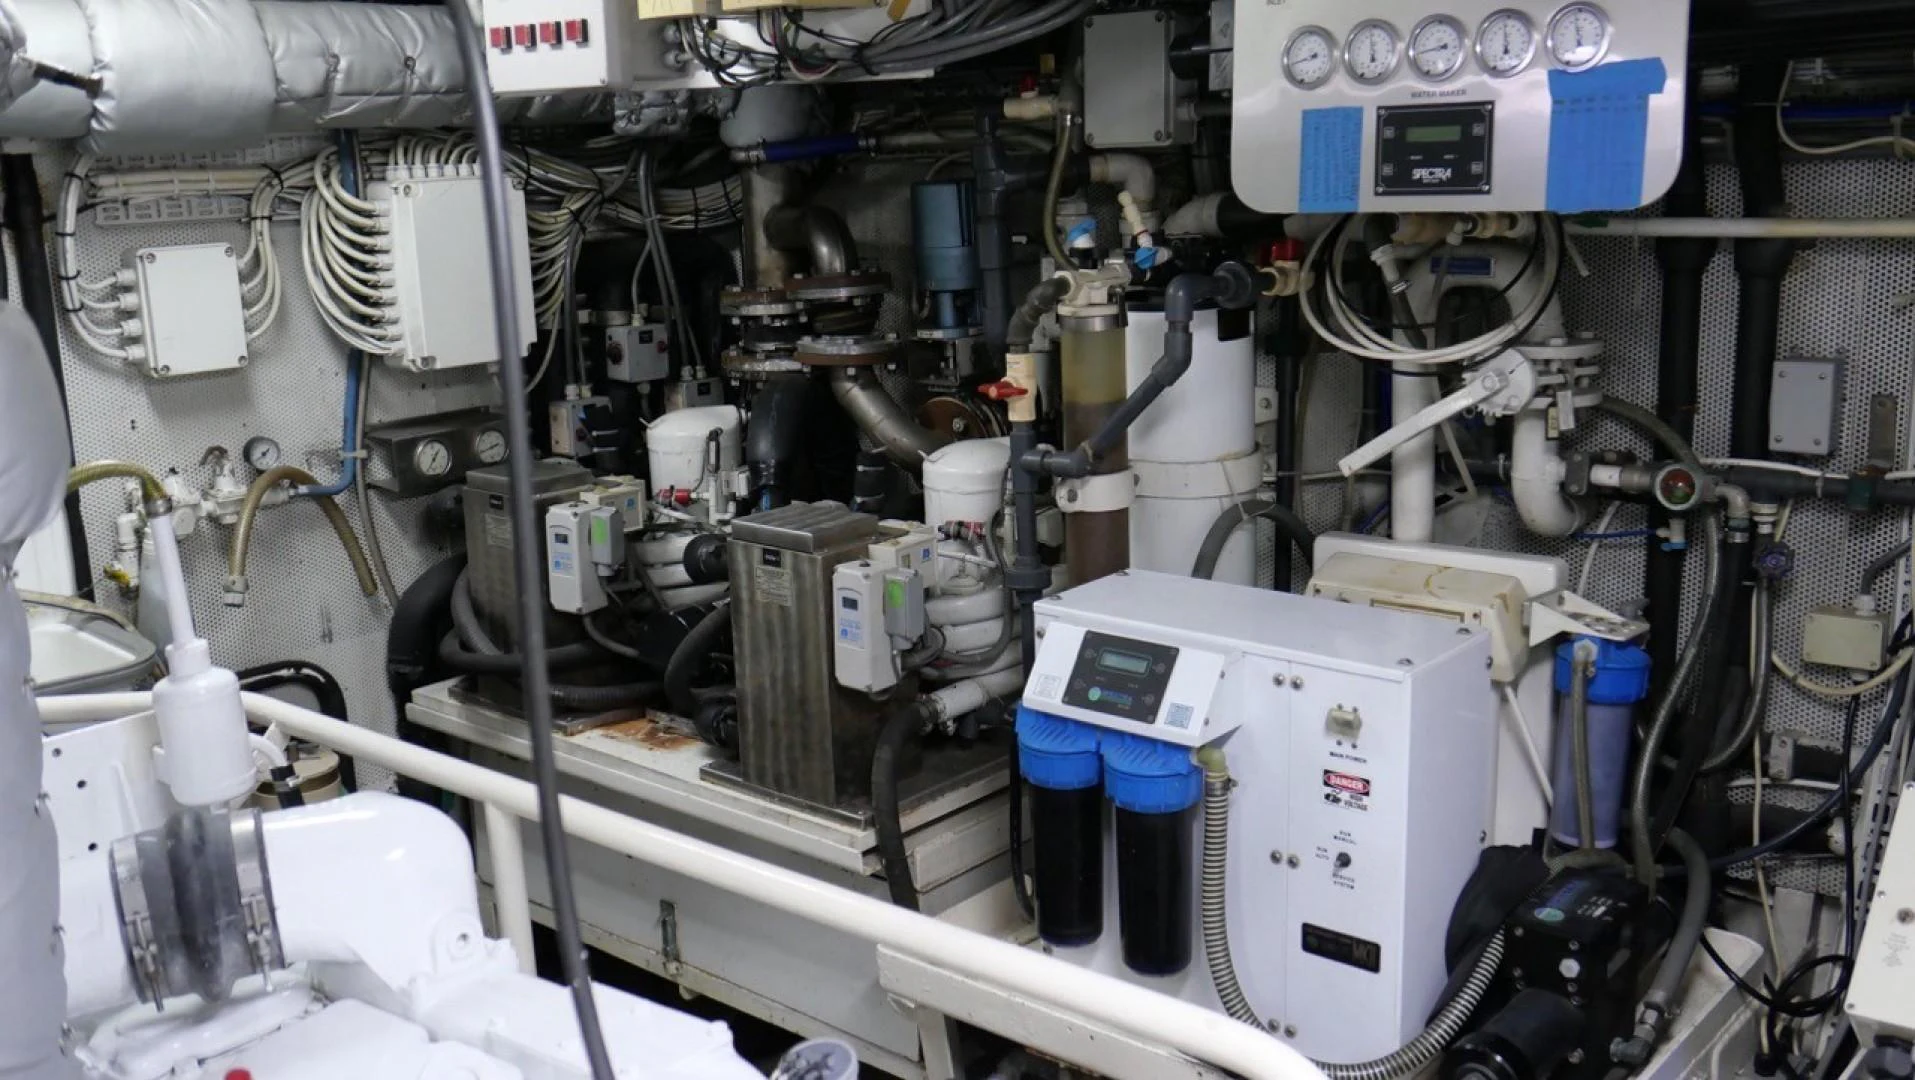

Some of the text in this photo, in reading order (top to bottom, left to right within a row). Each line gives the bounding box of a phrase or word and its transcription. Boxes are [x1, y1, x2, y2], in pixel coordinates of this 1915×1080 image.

[1410, 89, 1467, 98] WATER MAKER
[1411, 167, 1452, 182] SPECTRA
[1329, 774, 1364, 792] DANGER
[1344, 800, 1368, 811] VOLTAGE
